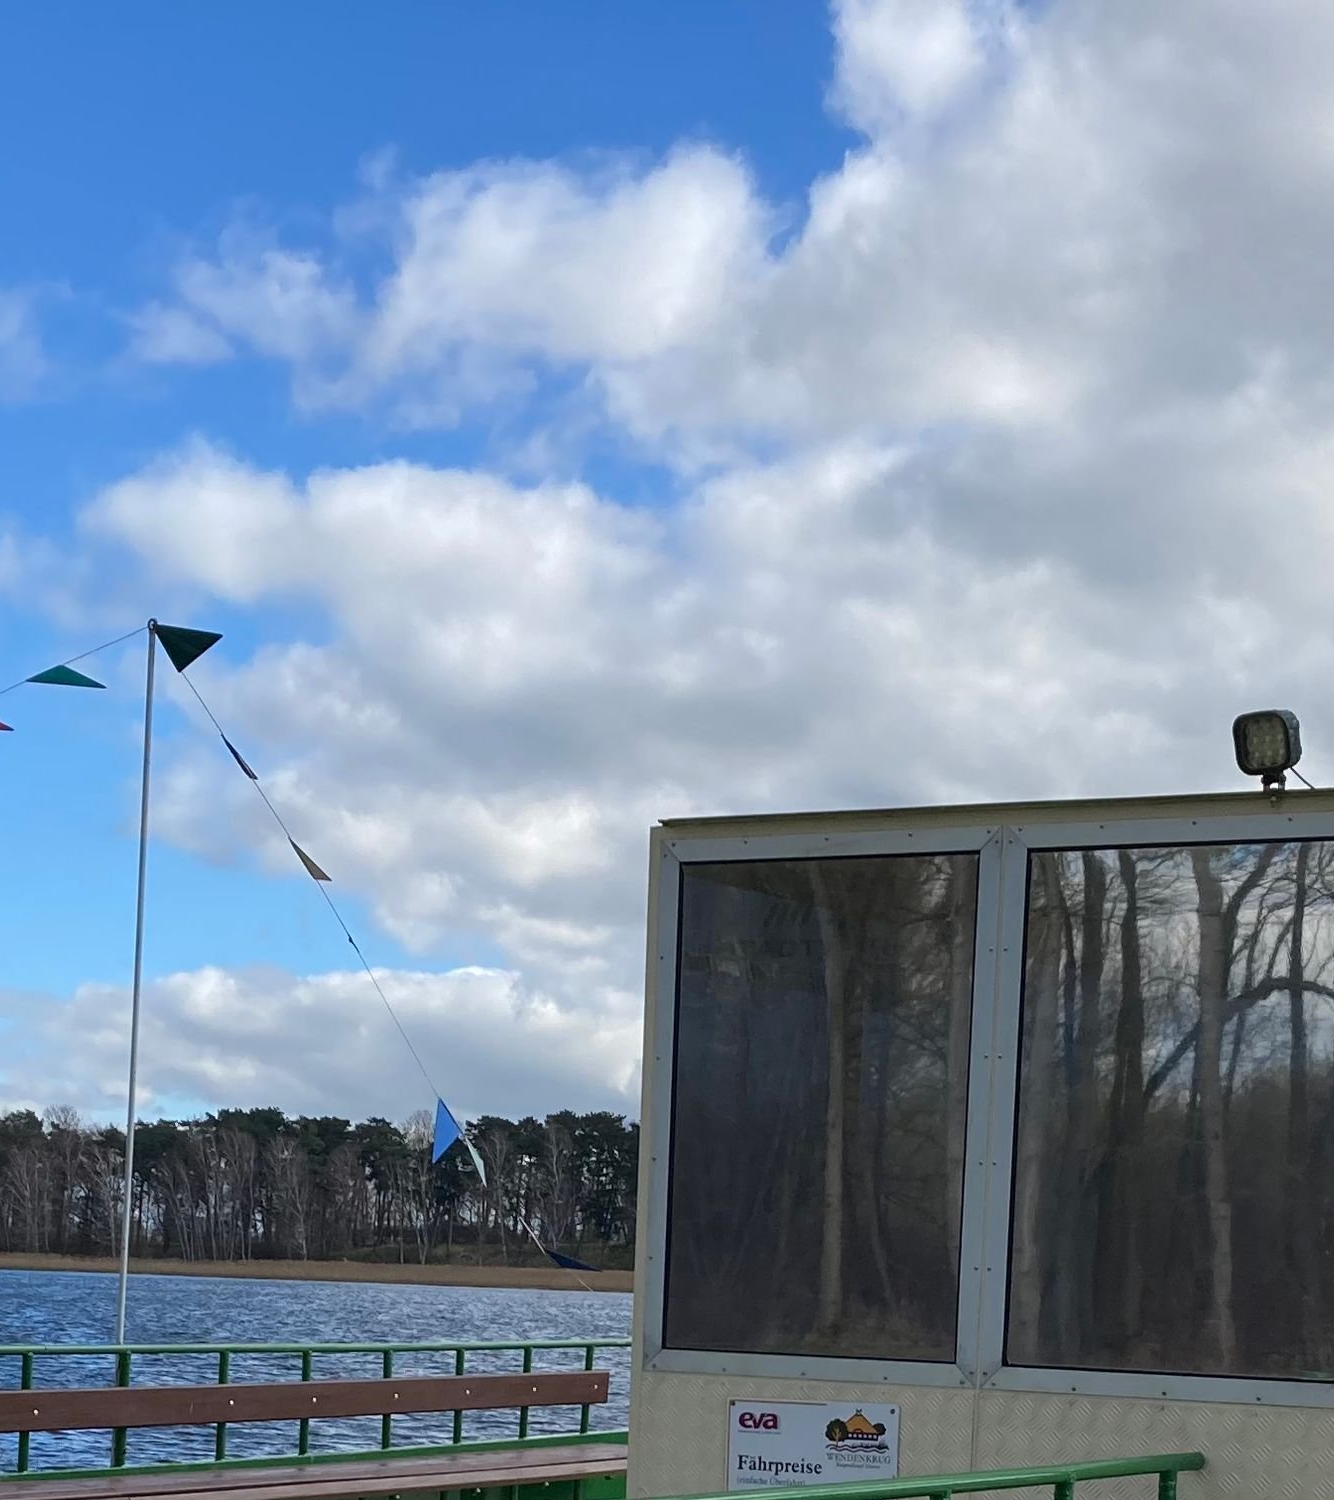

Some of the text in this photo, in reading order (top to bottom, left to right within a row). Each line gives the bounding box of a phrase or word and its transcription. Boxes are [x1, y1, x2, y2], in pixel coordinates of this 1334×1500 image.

[739, 1411, 779, 1430] eva
[737, 1454, 823, 1476] Fährpreise
[826, 1452, 892, 1465] WENDENKRUG
